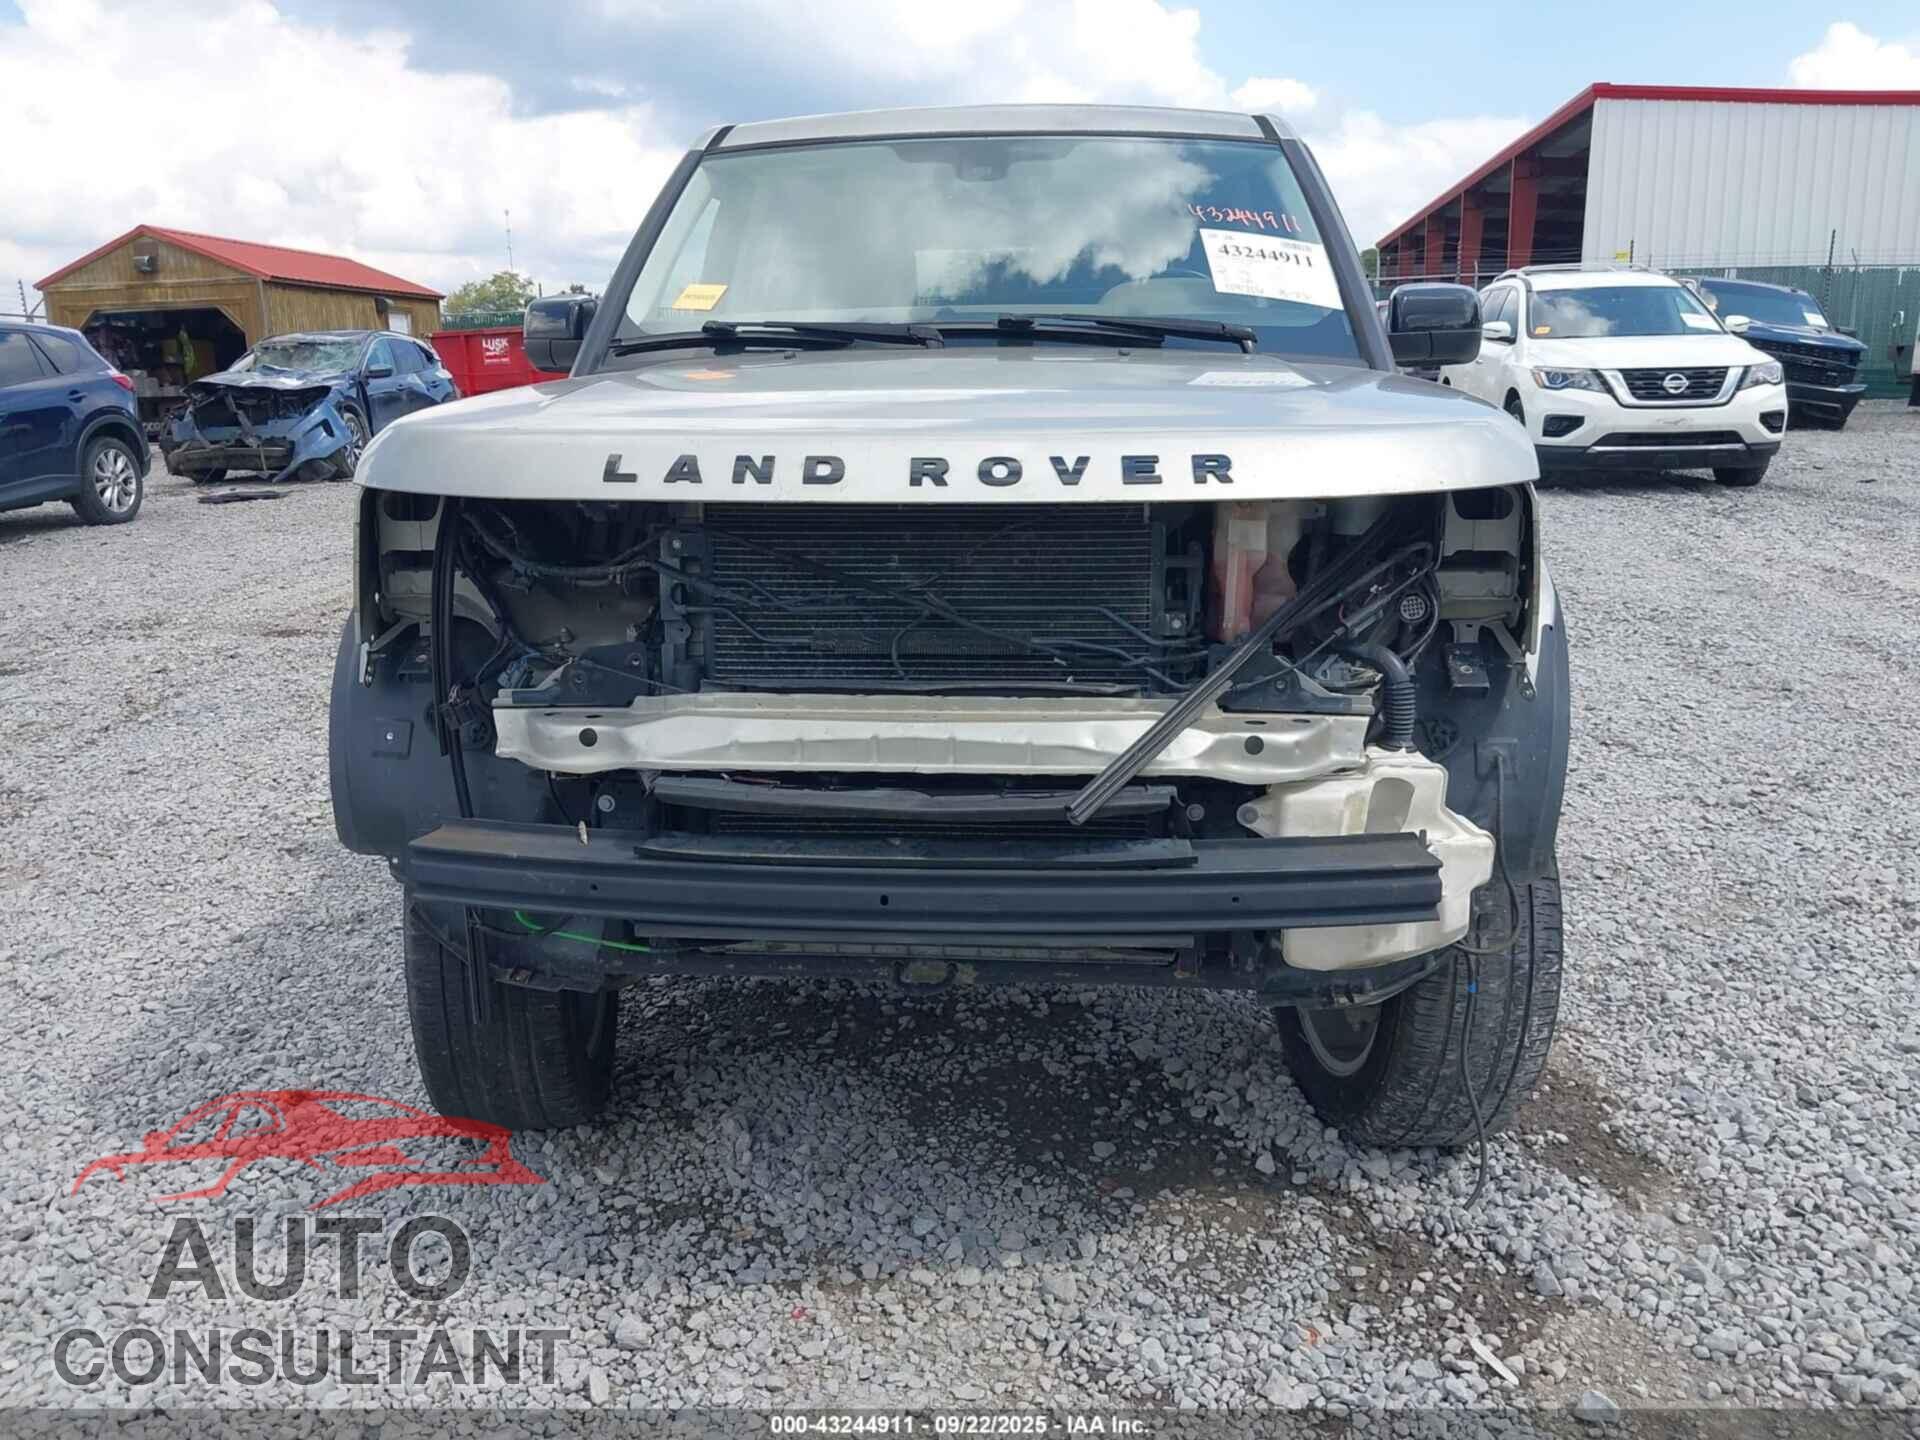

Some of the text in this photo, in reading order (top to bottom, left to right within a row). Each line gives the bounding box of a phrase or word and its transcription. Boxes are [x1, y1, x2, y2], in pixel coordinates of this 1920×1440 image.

[1187, 204, 1302, 233] 43244911
[1218, 243, 1314, 268] 43244911
[482, 338, 508, 351] LUSK
[602, 453, 1234, 487] LAND ROVER
